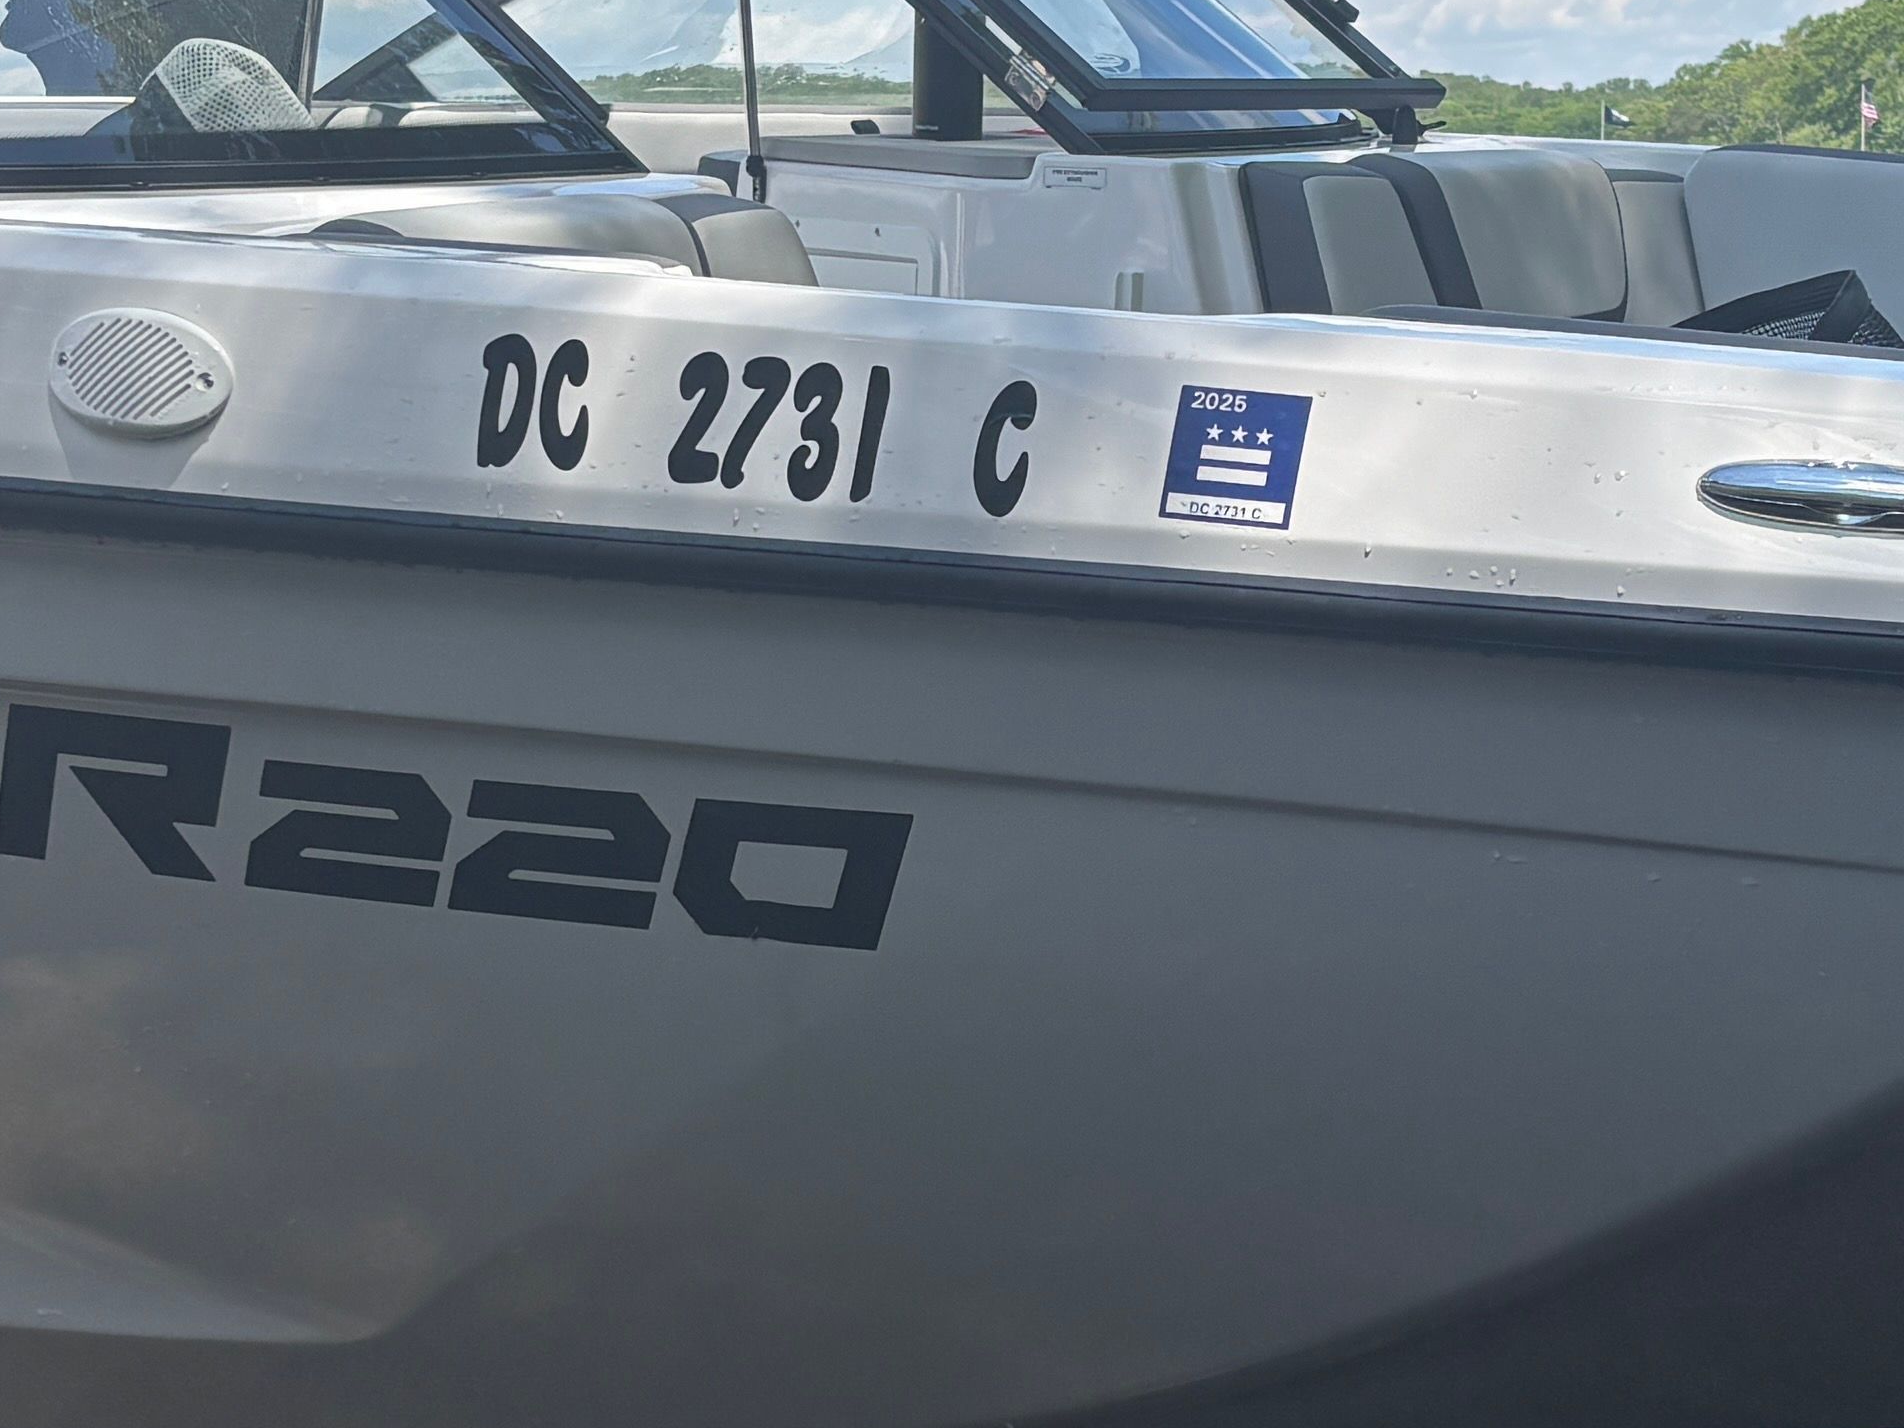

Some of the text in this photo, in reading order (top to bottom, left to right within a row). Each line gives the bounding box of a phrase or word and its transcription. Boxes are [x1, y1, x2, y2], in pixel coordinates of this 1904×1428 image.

[1190, 391, 1247, 413] 2025
[477, 333, 1037, 517] DC 2731 C
[1189, 501, 1262, 520] DC 2731 C
